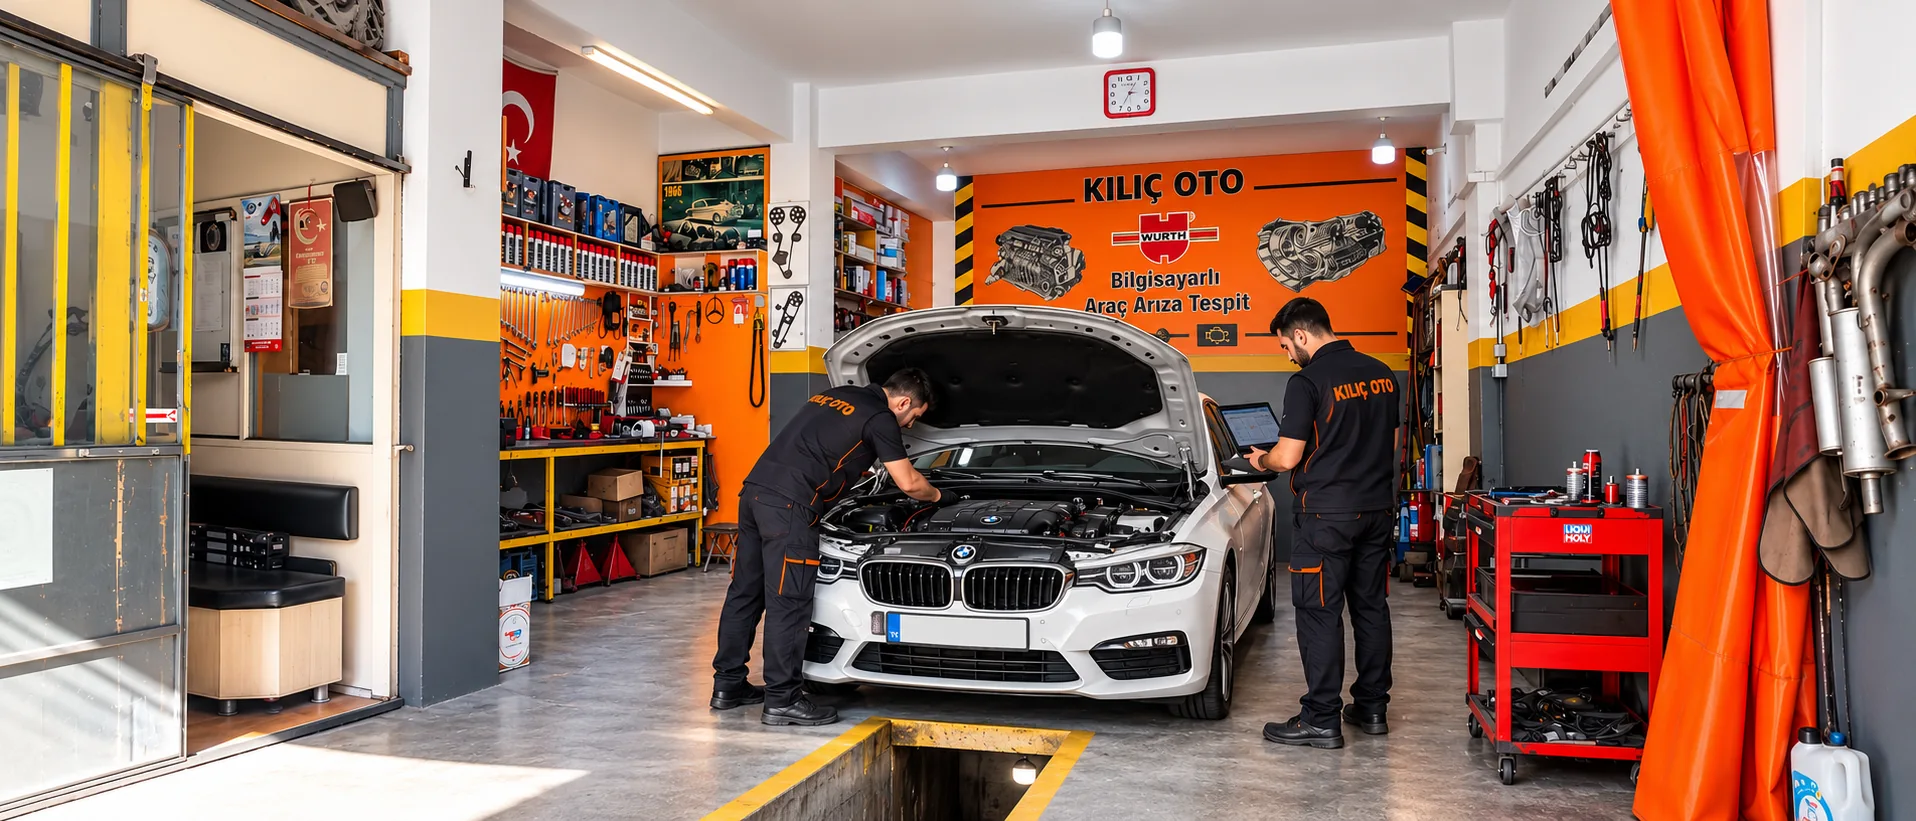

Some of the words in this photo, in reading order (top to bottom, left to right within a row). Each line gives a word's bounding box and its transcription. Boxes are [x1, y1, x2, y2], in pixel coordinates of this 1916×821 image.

[1083, 173, 1163, 205] KILIÇ
[1173, 168, 1245, 197] OTO
[1111, 268, 1220, 292] Bilgisayarlı
[1085, 297, 1127, 318] Araç
[1133, 296, 1183, 314] Arıza
[1188, 292, 1251, 315] Tespit
[1333, 381, 1369, 402] KILIÇ
[1369, 378, 1394, 395] OTO
[828, 398, 856, 416] OTO
